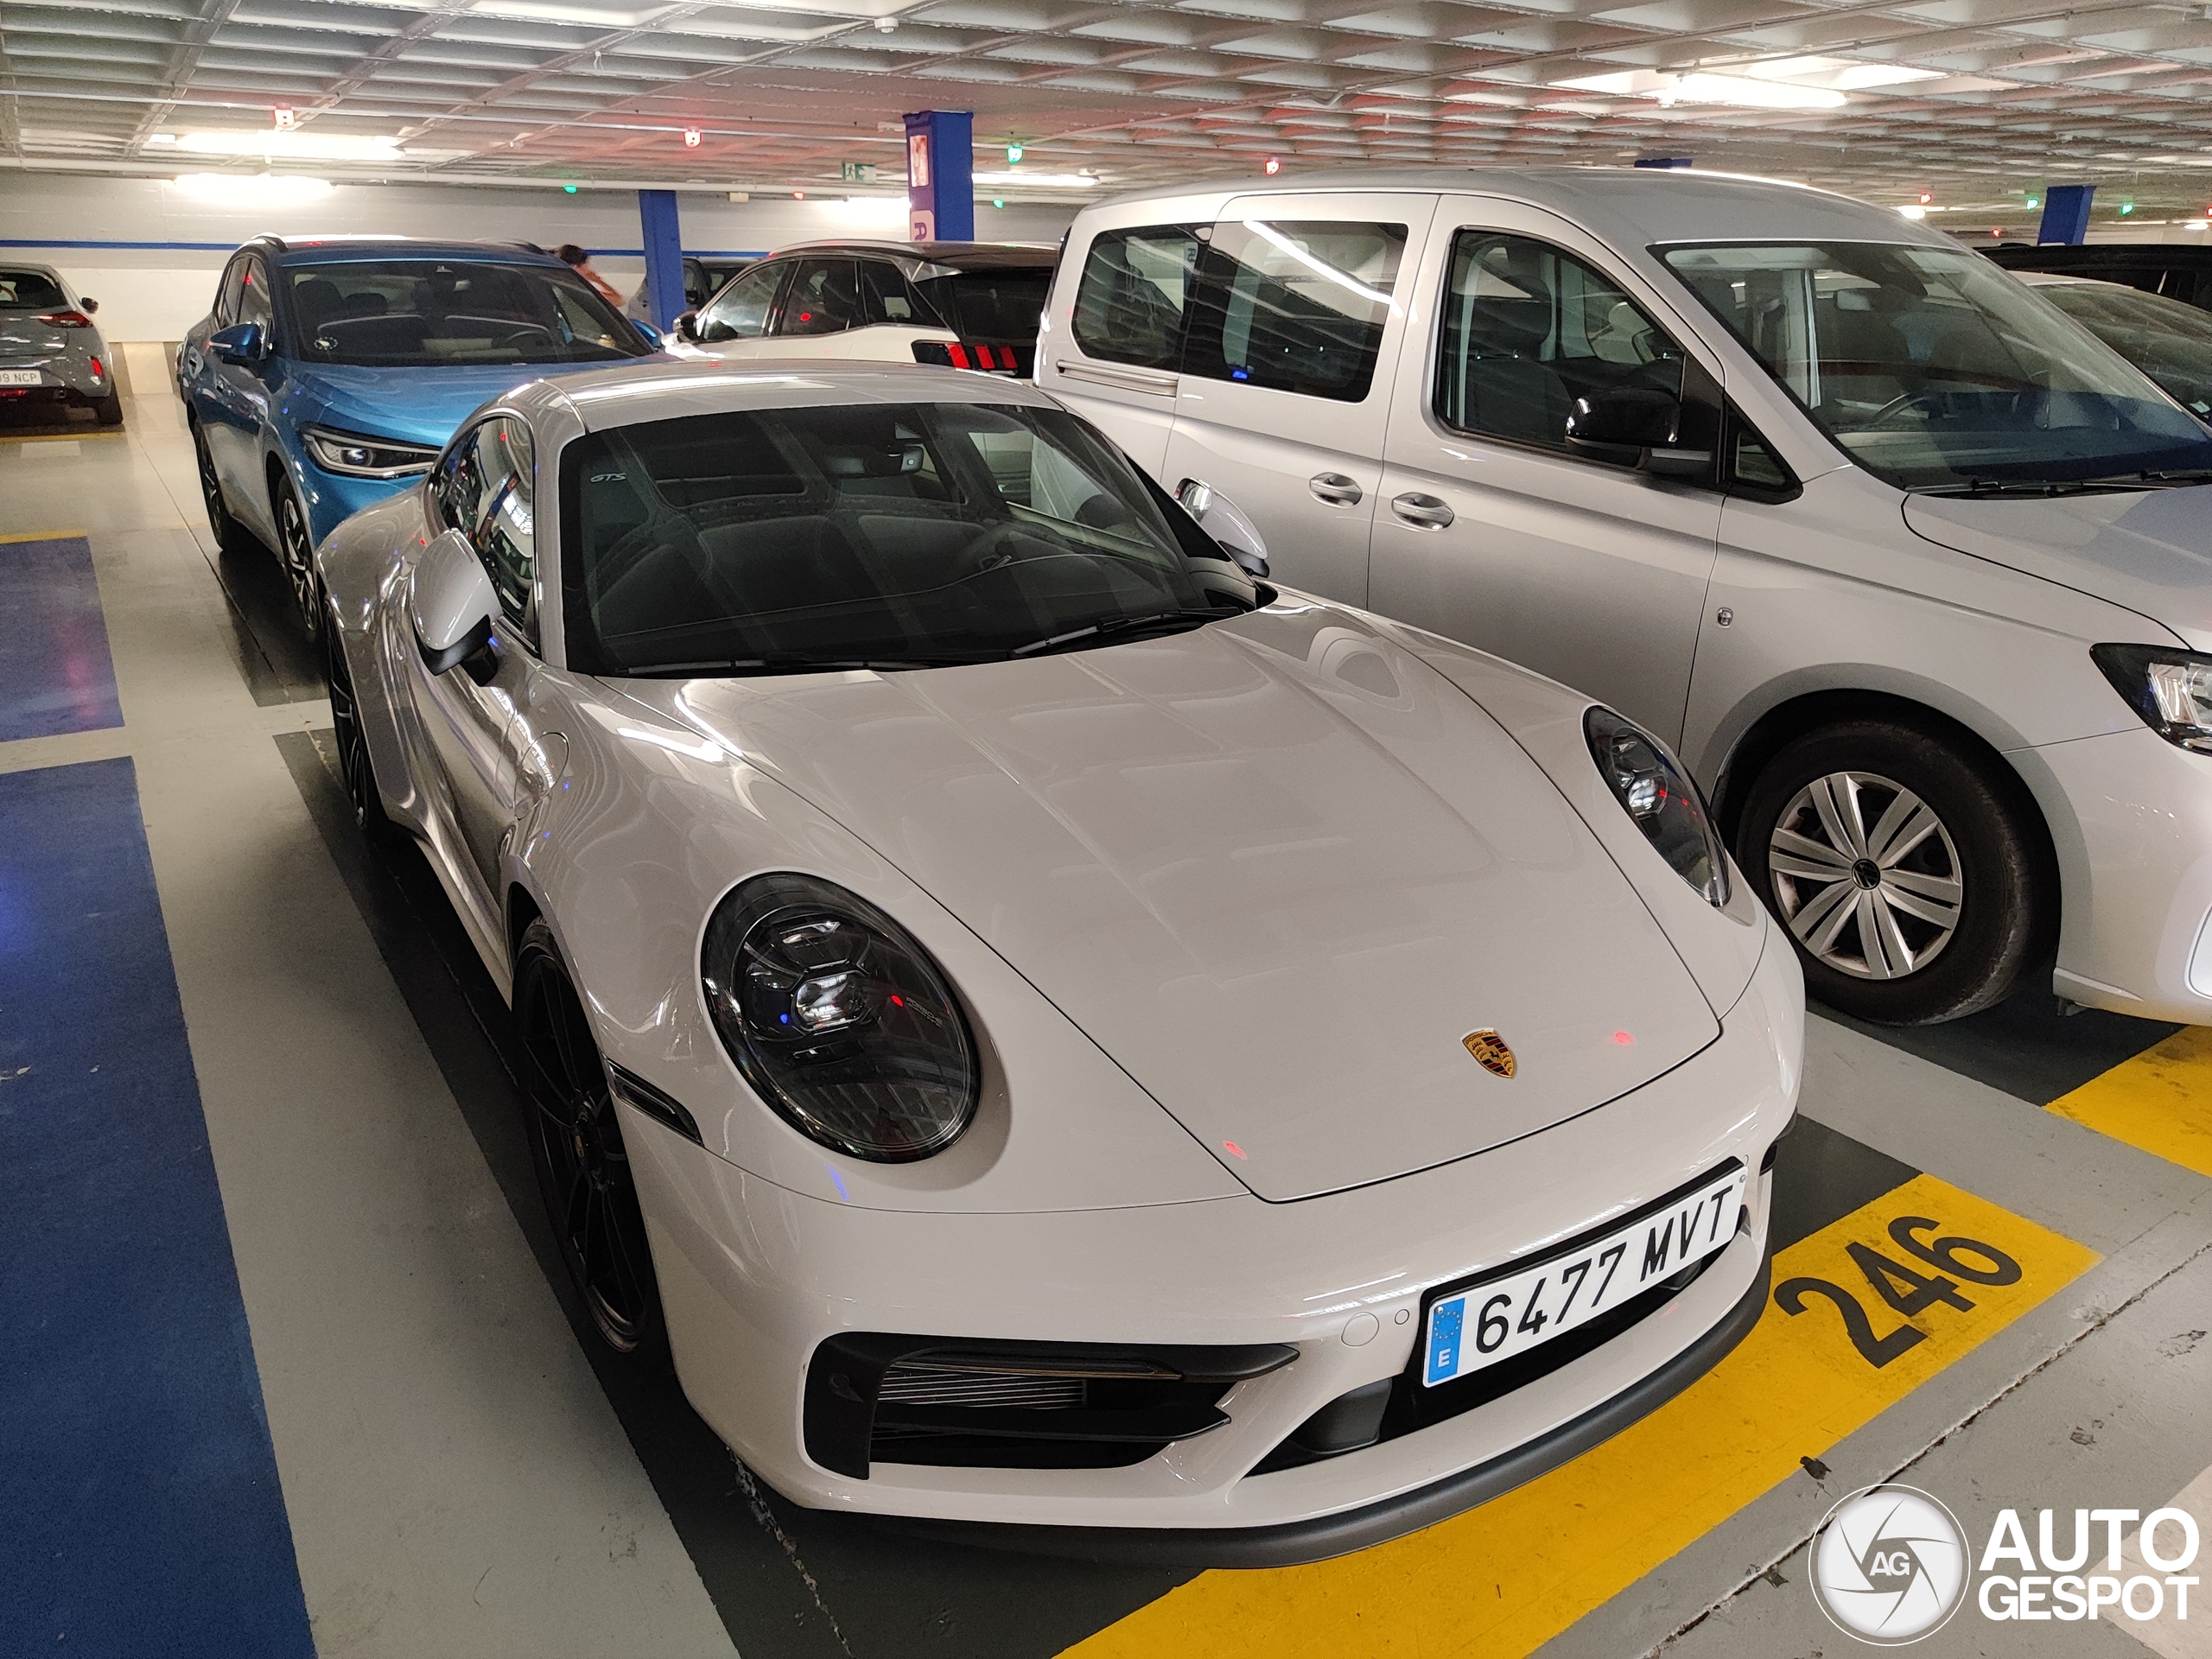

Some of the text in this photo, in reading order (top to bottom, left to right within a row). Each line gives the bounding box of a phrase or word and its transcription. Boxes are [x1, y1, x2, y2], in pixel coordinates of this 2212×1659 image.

[14, 372, 37, 383] NCP
[590, 472, 626, 483] GTS
[1475, 1184, 1733, 1354] 6477 MVT
[1772, 1216, 2024, 1369] 246
[1438, 1348, 1452, 1368] E
